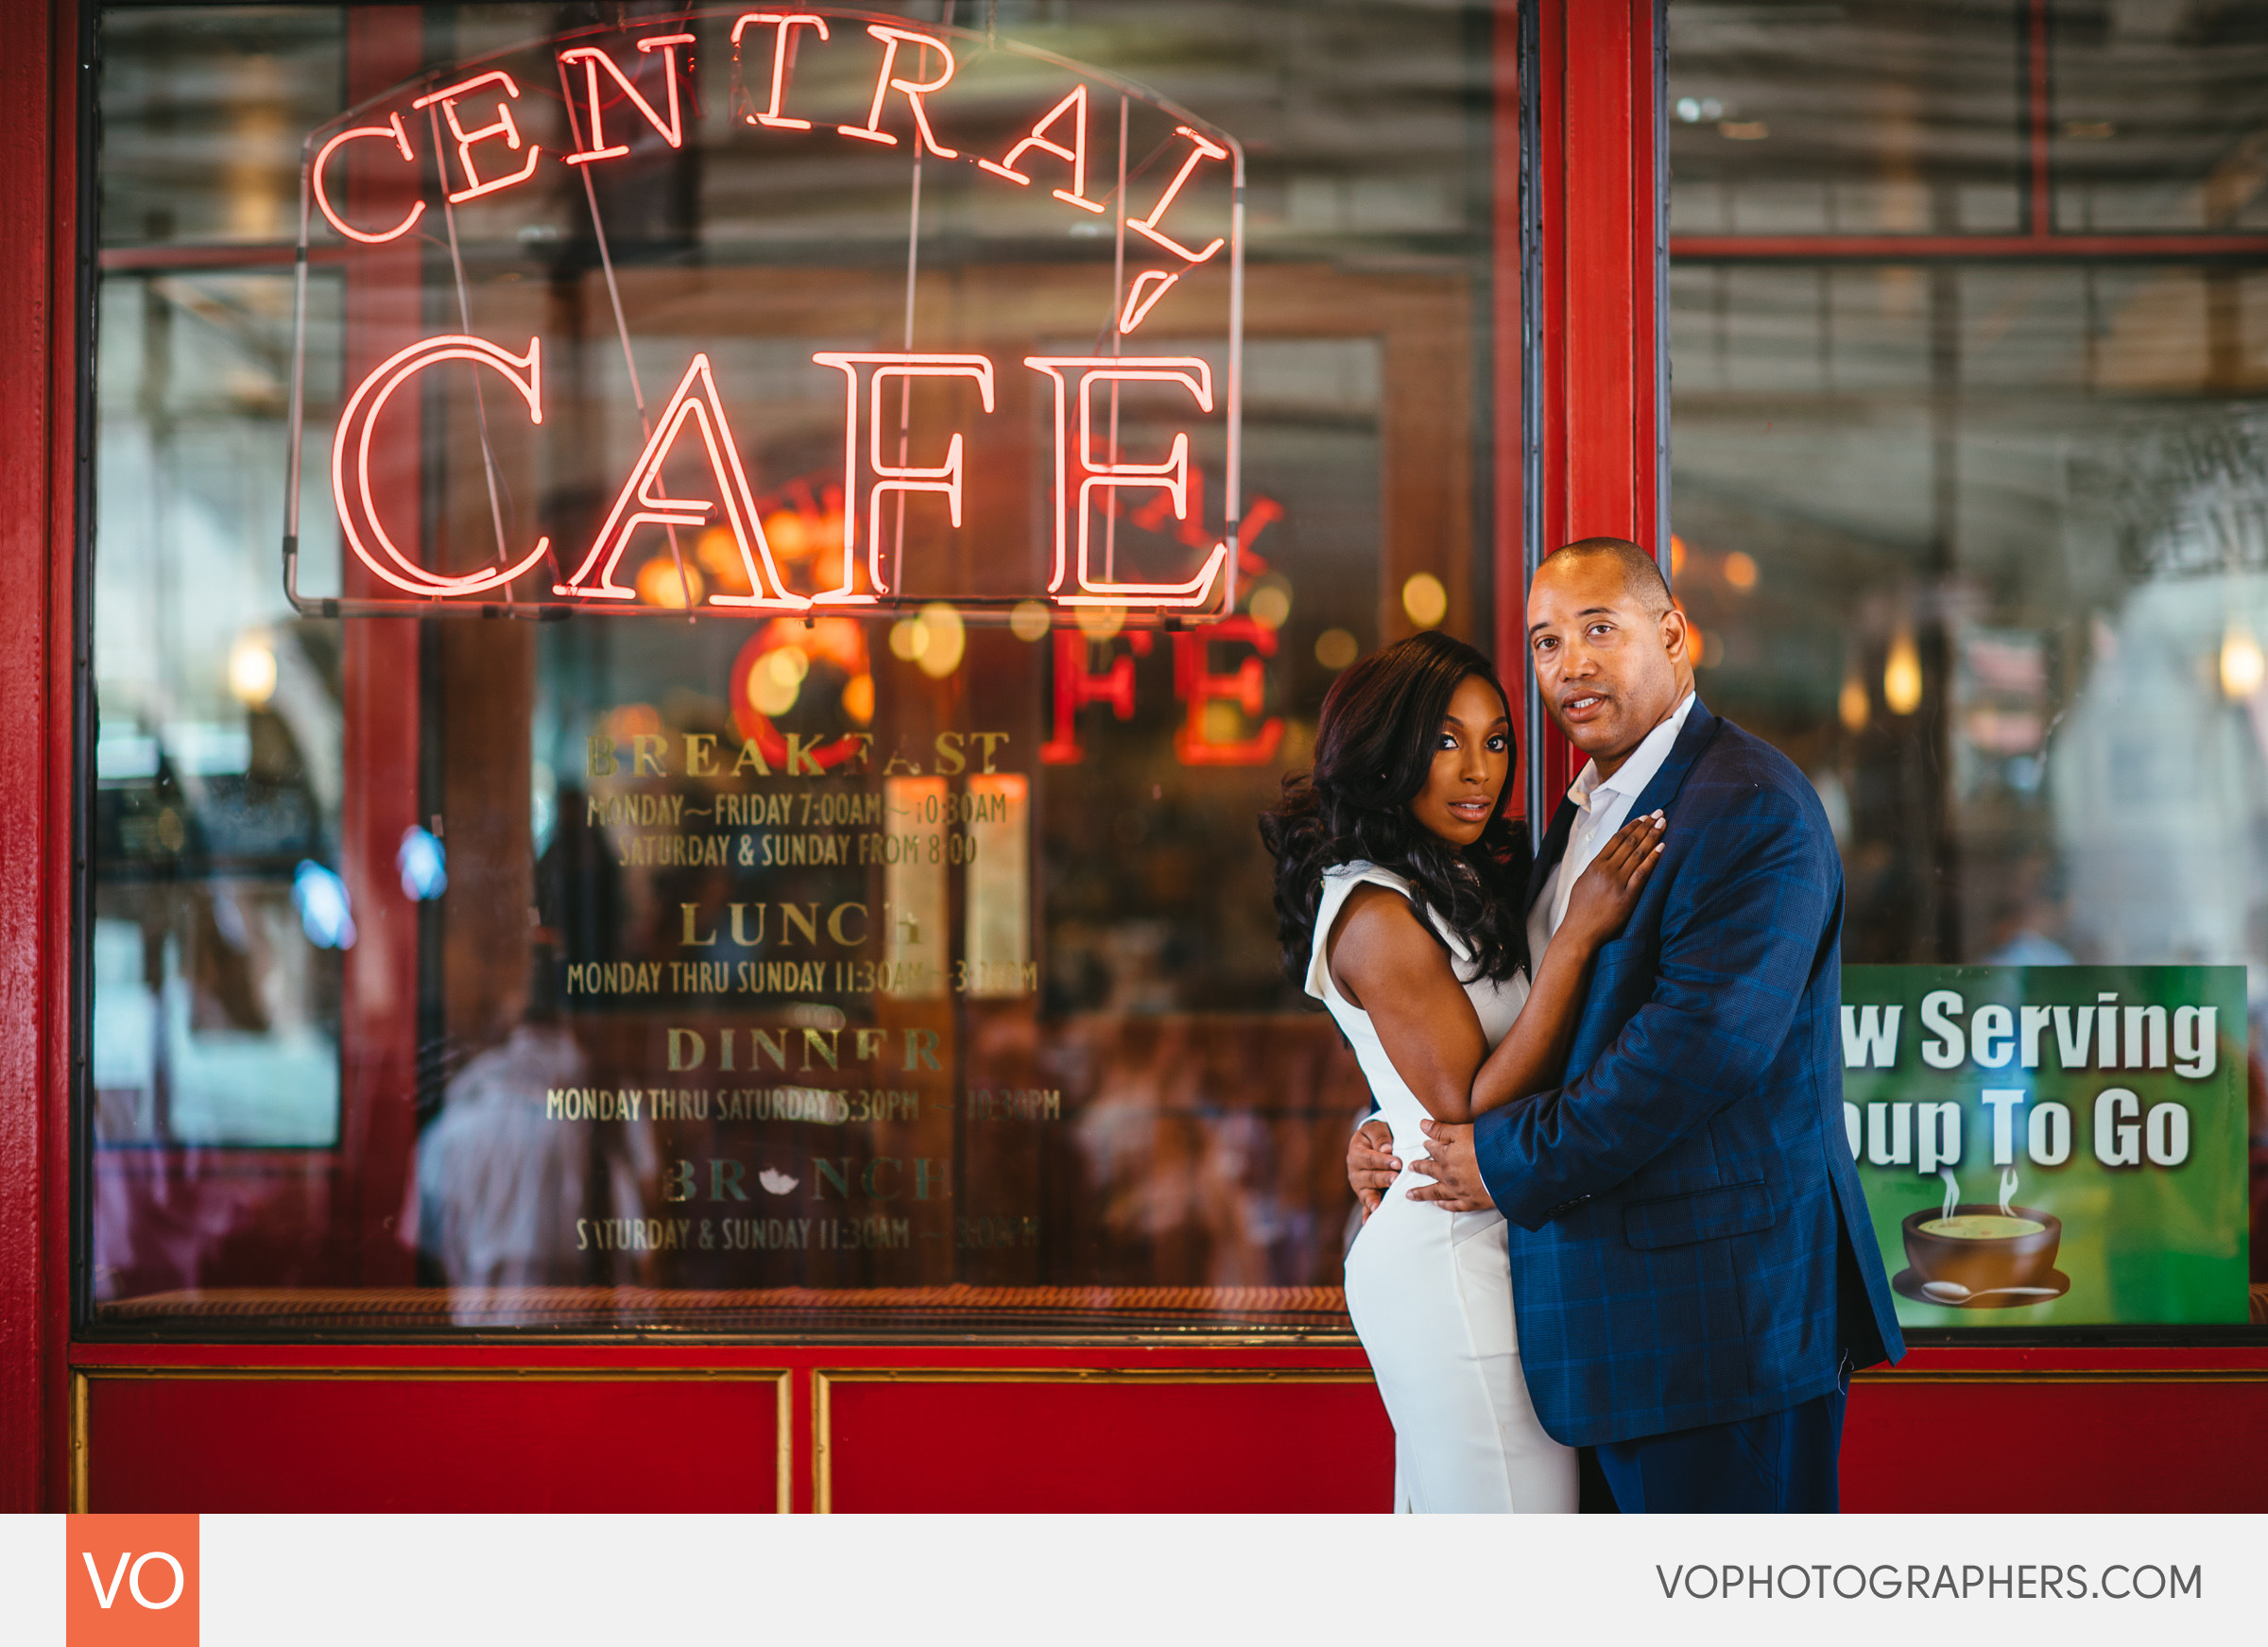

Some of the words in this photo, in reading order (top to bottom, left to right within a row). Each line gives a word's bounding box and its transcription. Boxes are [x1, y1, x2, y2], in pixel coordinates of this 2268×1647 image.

[311, 12, 1228, 263] CENTRAL
[330, 270, 1227, 609] CAFÉ
[799, 793, 881, 826] 7:00AM
[916, 793, 1006, 825] 10:30AM
[619, 834, 730, 866] SATURDAY
[738, 833, 754, 866] &
[762, 833, 850, 866] SUNDAY
[858, 832, 919, 866] FROM
[928, 833, 977, 865] 8:00
[567, 961, 662, 994] MONDAY
[668, 961, 730, 993] THRU
[737, 961, 827, 993] SUNDAY
[835, 961, 923, 992] 11:30AM
[1920, 989, 2218, 1078] Serving
[545, 1088, 643, 1122] MONDAY
[647, 1088, 708, 1121] THRU
[716, 1089, 831, 1122] SATURDAY
[968, 1089, 1060, 1121] 10:30PM
[1982, 1089, 2071, 1167] To
[2094, 1088, 2189, 1166] Go
[663, 1157, 947, 1202] BRNCH
[697, 1217, 714, 1249] &
[722, 1217, 811, 1250] SUNDAY
[819, 1217, 910, 1249] 11:30AM
